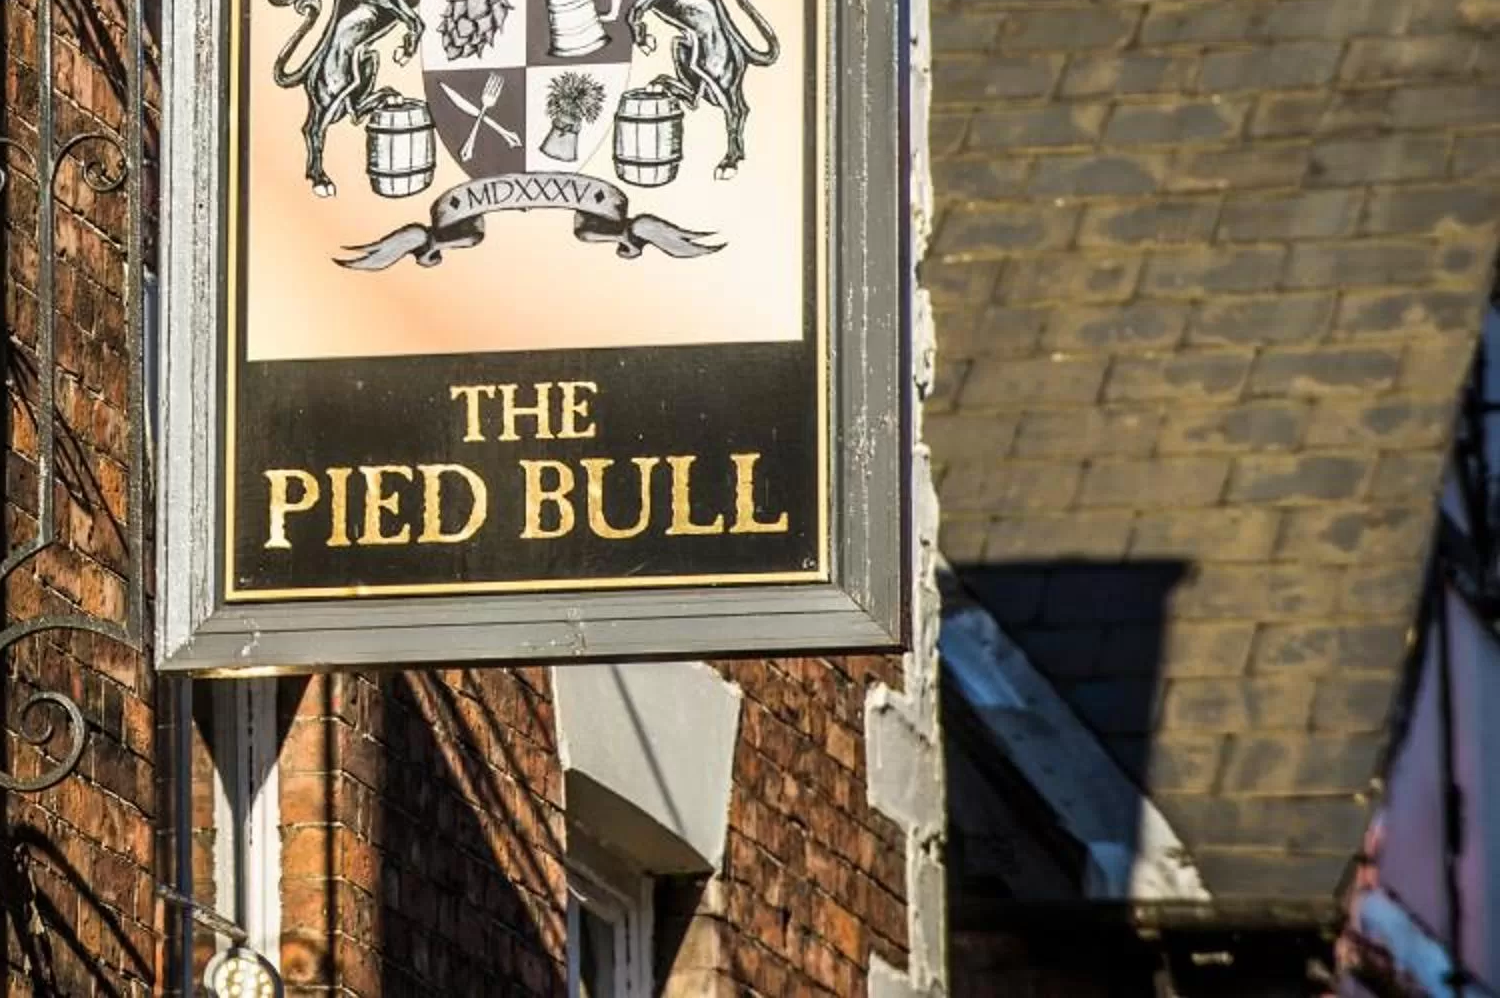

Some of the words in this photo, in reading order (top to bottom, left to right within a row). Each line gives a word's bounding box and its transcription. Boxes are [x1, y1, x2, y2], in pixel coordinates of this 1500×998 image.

[466, 177, 591, 209] MDXXXV
[450, 381, 598, 443] THE
[263, 463, 488, 549] PIED
[518, 452, 789, 540] BULL
